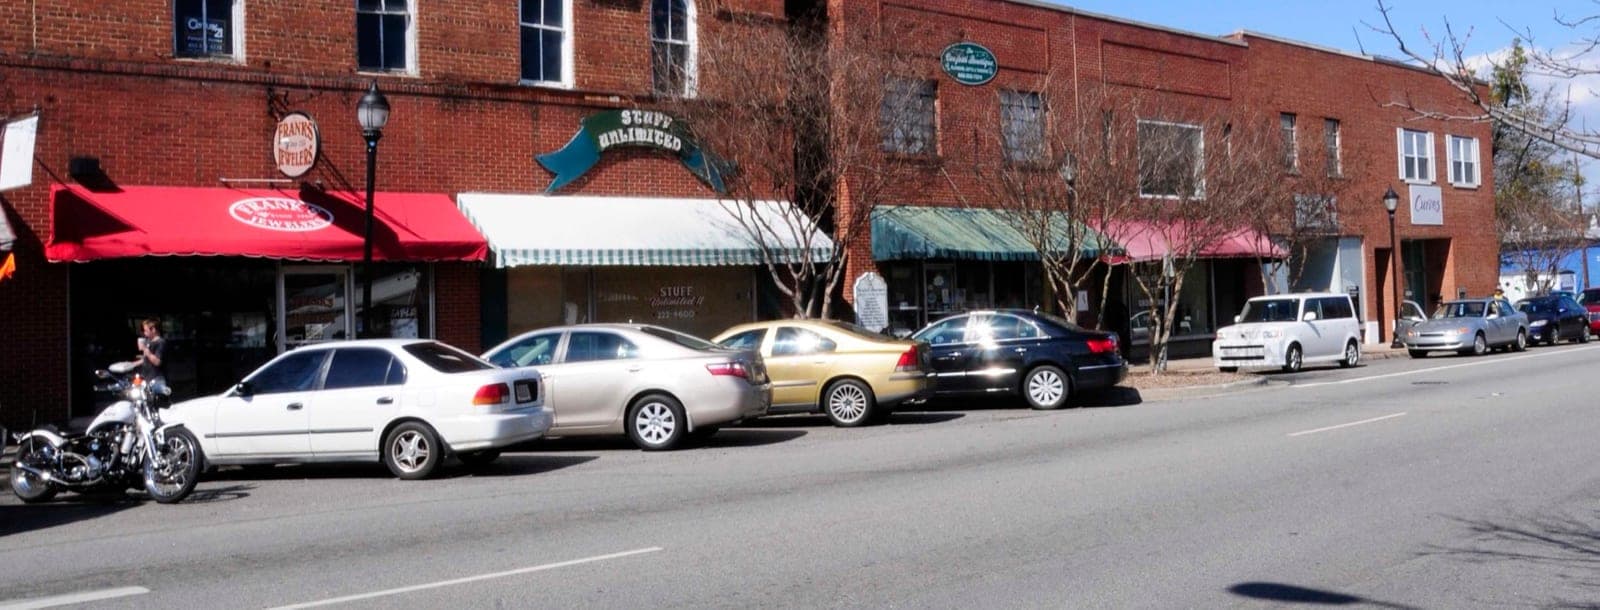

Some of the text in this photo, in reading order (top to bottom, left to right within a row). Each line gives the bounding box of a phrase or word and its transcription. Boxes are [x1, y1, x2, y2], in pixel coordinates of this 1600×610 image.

[621, 109, 673, 129] STUFF
[598, 127, 682, 151] UNLIMITED
[1414, 194, 1440, 213] Curves
[660, 286, 694, 297] STUFF
